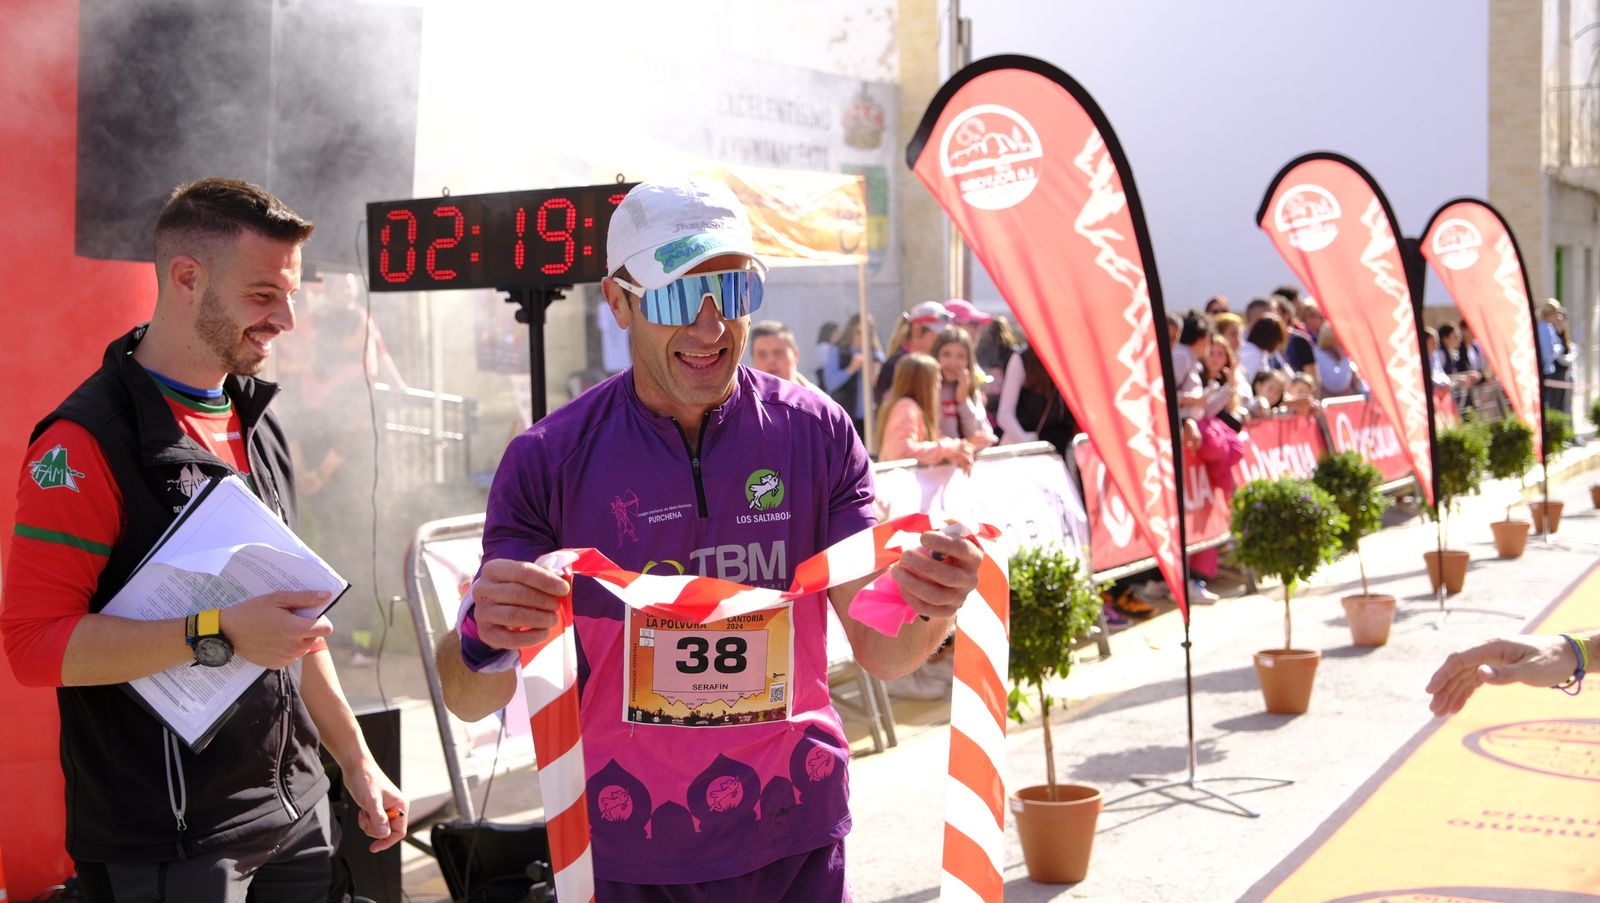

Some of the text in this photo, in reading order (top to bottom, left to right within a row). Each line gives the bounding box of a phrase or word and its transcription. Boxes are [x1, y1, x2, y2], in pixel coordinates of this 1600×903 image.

[35, 463, 64, 485] FAM
[648, 511, 683, 524] PURCHENA
[736, 515, 752, 524] LOS
[689, 540, 788, 584] TBM
[646, 618, 658, 628] LA
[726, 614, 764, 623] CANTORIA
[675, 636, 748, 675] 38
